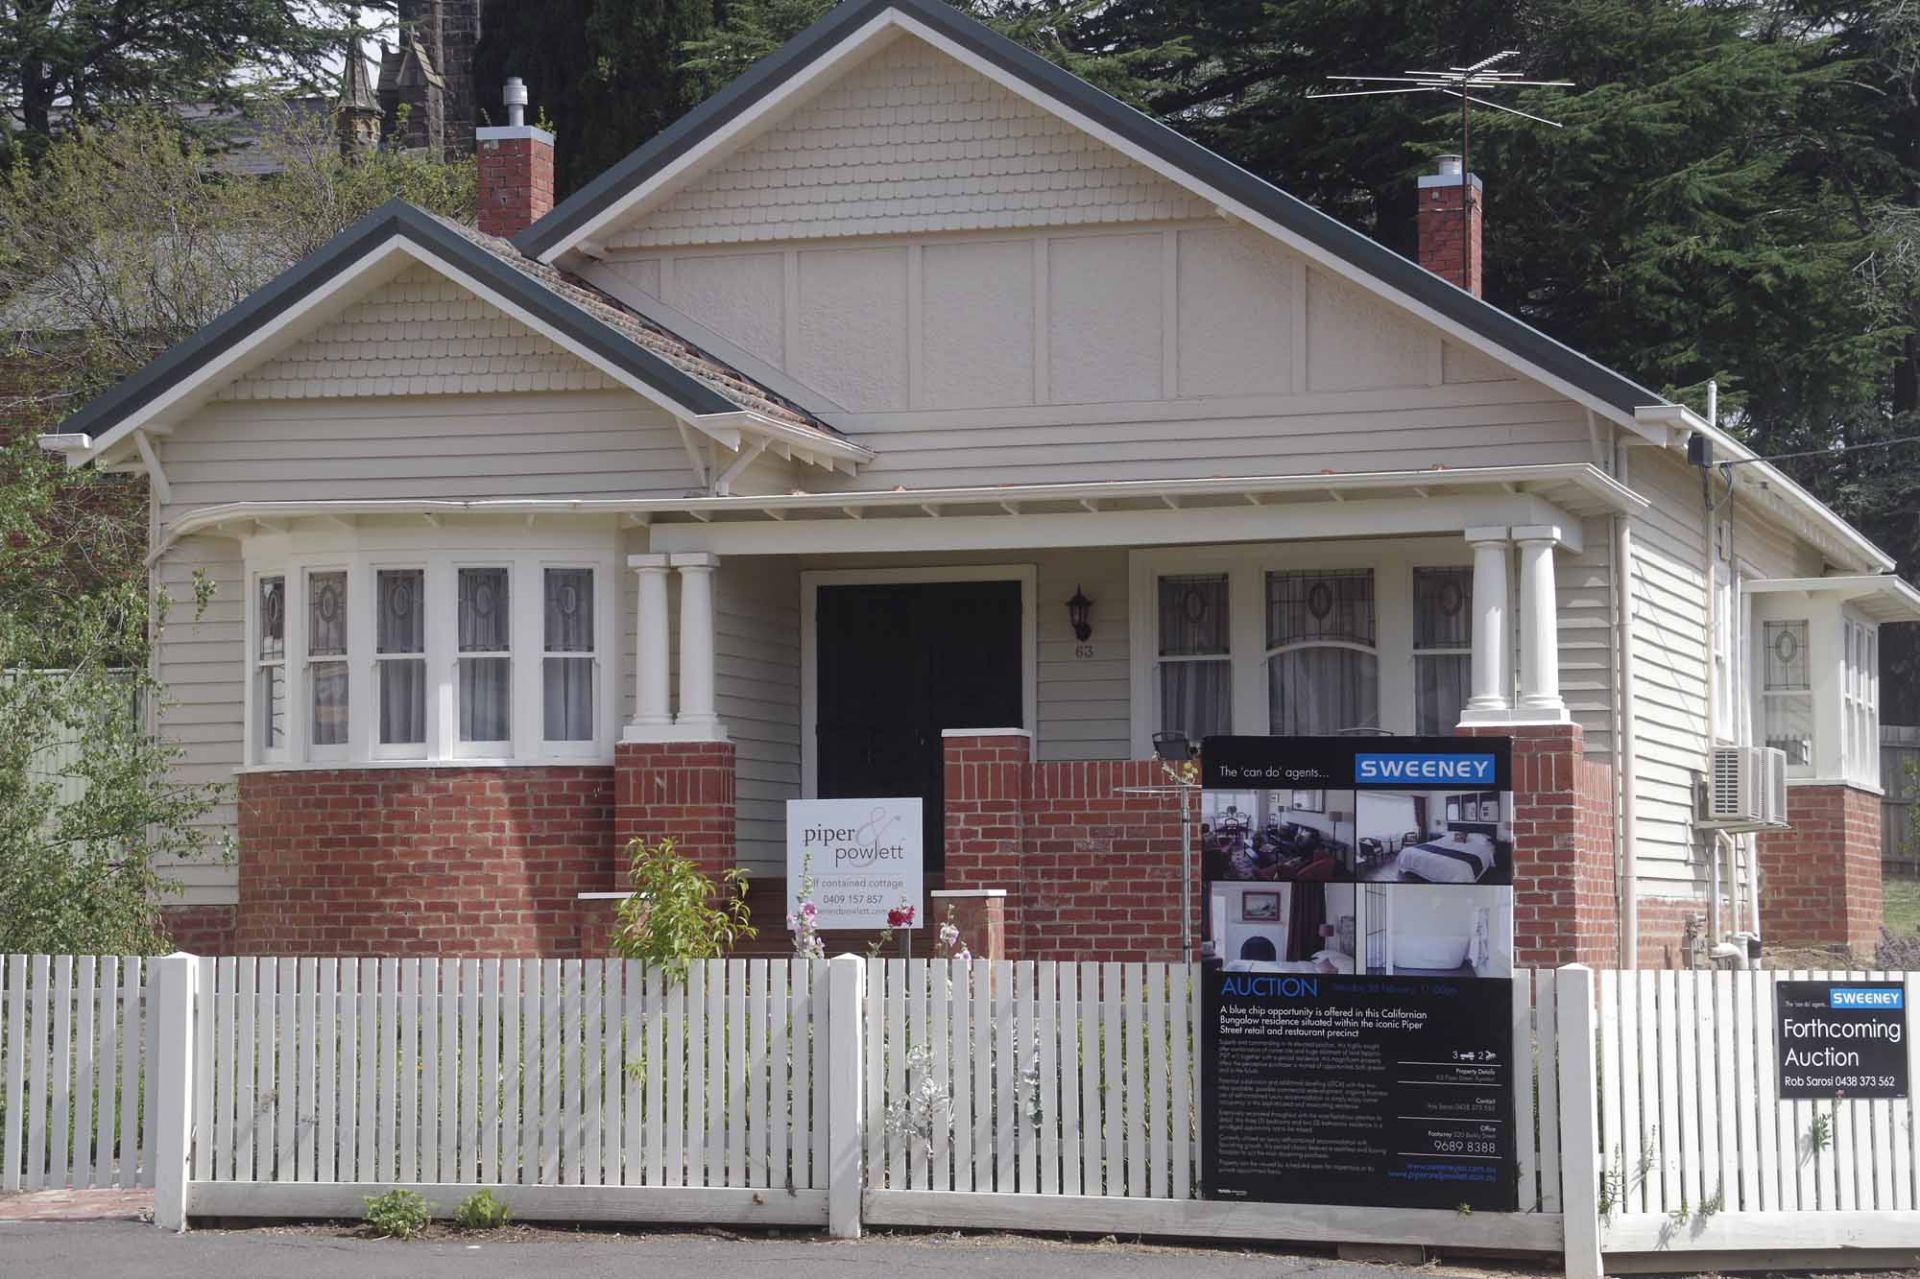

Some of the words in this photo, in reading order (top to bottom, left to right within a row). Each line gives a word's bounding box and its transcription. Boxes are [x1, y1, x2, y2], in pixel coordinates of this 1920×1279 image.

[1219, 766, 1238, 777] The
[1361, 761, 1489, 777] SWEENEY
[805, 824, 855, 846] piper
[836, 840, 904, 868] powlett
[822, 879, 867, 889] contained
[869, 879, 904, 890] cottage
[823, 895, 845, 904] 0409
[849, 895, 864, 904] 157
[866, 895, 883, 904] 857
[1221, 977, 1318, 997] AUCTION
[1833, 993, 1899, 1004] SWEENEY
[1220, 1005, 1227, 1014] A
[1229, 1005, 1246, 1014] blue
[1249, 1005, 1265, 1017] chip
[1268, 1007, 1313, 1019] opportunity
[1315, 1008, 1322, 1016] is
[1324, 1007, 1353, 1017] offered
[1355, 1008, 1363, 1017] in
[1365, 1008, 1379, 1018] this
[1381, 1008, 1427, 1019] Californian
[1220, 1015, 1259, 1027] Bungalow
[1262, 1017, 1299, 1025] residence
[1301, 1017, 1332, 1026] situated
[1335, 1018, 1359, 1027] within
[1361, 1018, 1373, 1028] the
[1375, 1019, 1400, 1029] iconic
[1402, 1020, 1423, 1032] Piper
[1784, 1018, 1901, 1043] Forthcoming
[1220, 1025, 1242, 1034] Street
[1245, 1025, 1265, 1035] retail
[1267, 1025, 1283, 1035] and
[1285, 1027, 1325, 1037] restaurant
[1327, 1029, 1359, 1039] precinct
[1452, 1051, 1458, 1060] 3
[1478, 1052, 1484, 1060] 2
[1785, 1047, 1859, 1067] Auction
[1785, 1076, 1804, 1087] Rob
[1806, 1076, 1833, 1087] Sarosi
[1835, 1076, 1858, 1087] 0438
[1860, 1076, 1876, 1087] 373
[1878, 1076, 1895, 1087] 562
[1434, 1140, 1464, 1152] 9689
[1467, 1142, 1496, 1153] 8388
